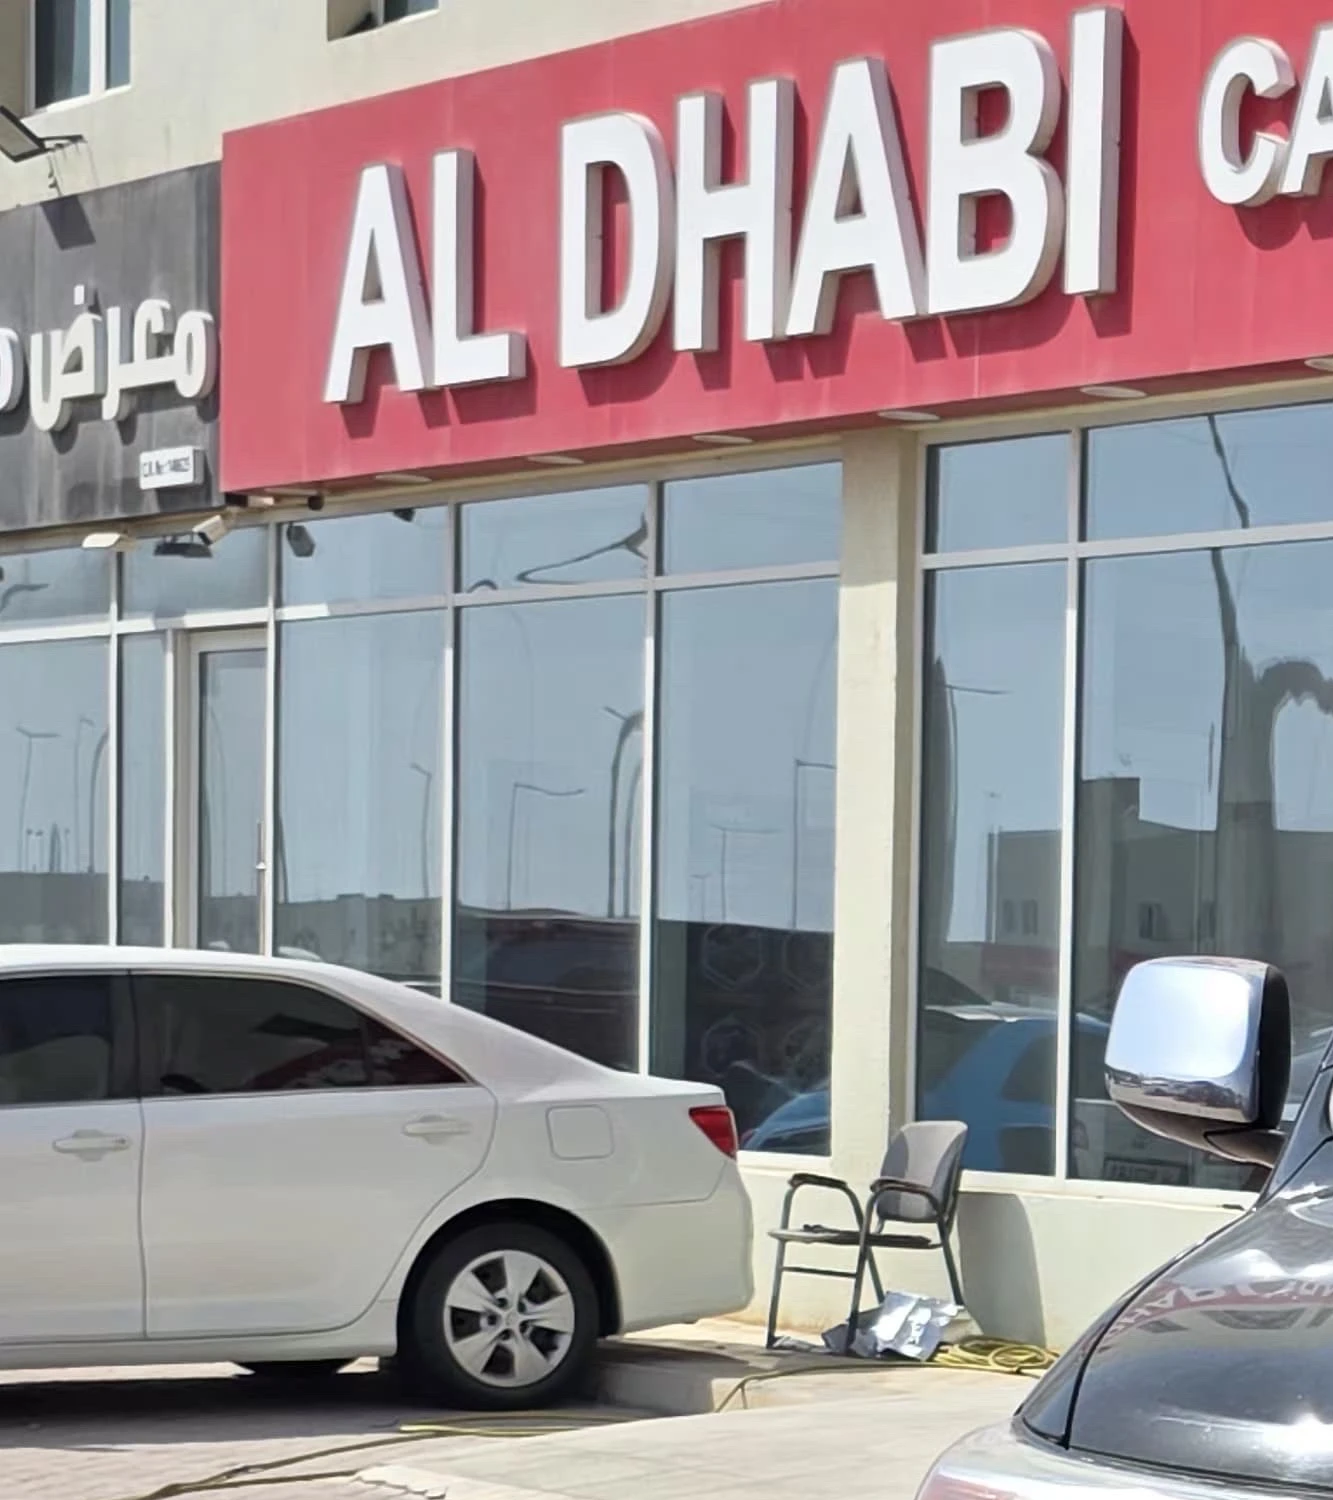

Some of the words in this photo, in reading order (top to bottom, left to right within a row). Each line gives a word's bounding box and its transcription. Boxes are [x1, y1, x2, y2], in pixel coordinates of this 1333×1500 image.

[323, 148, 525, 404] AL
[559, 6, 1123, 369] DHABI
[29, 284, 220, 432] معرض
